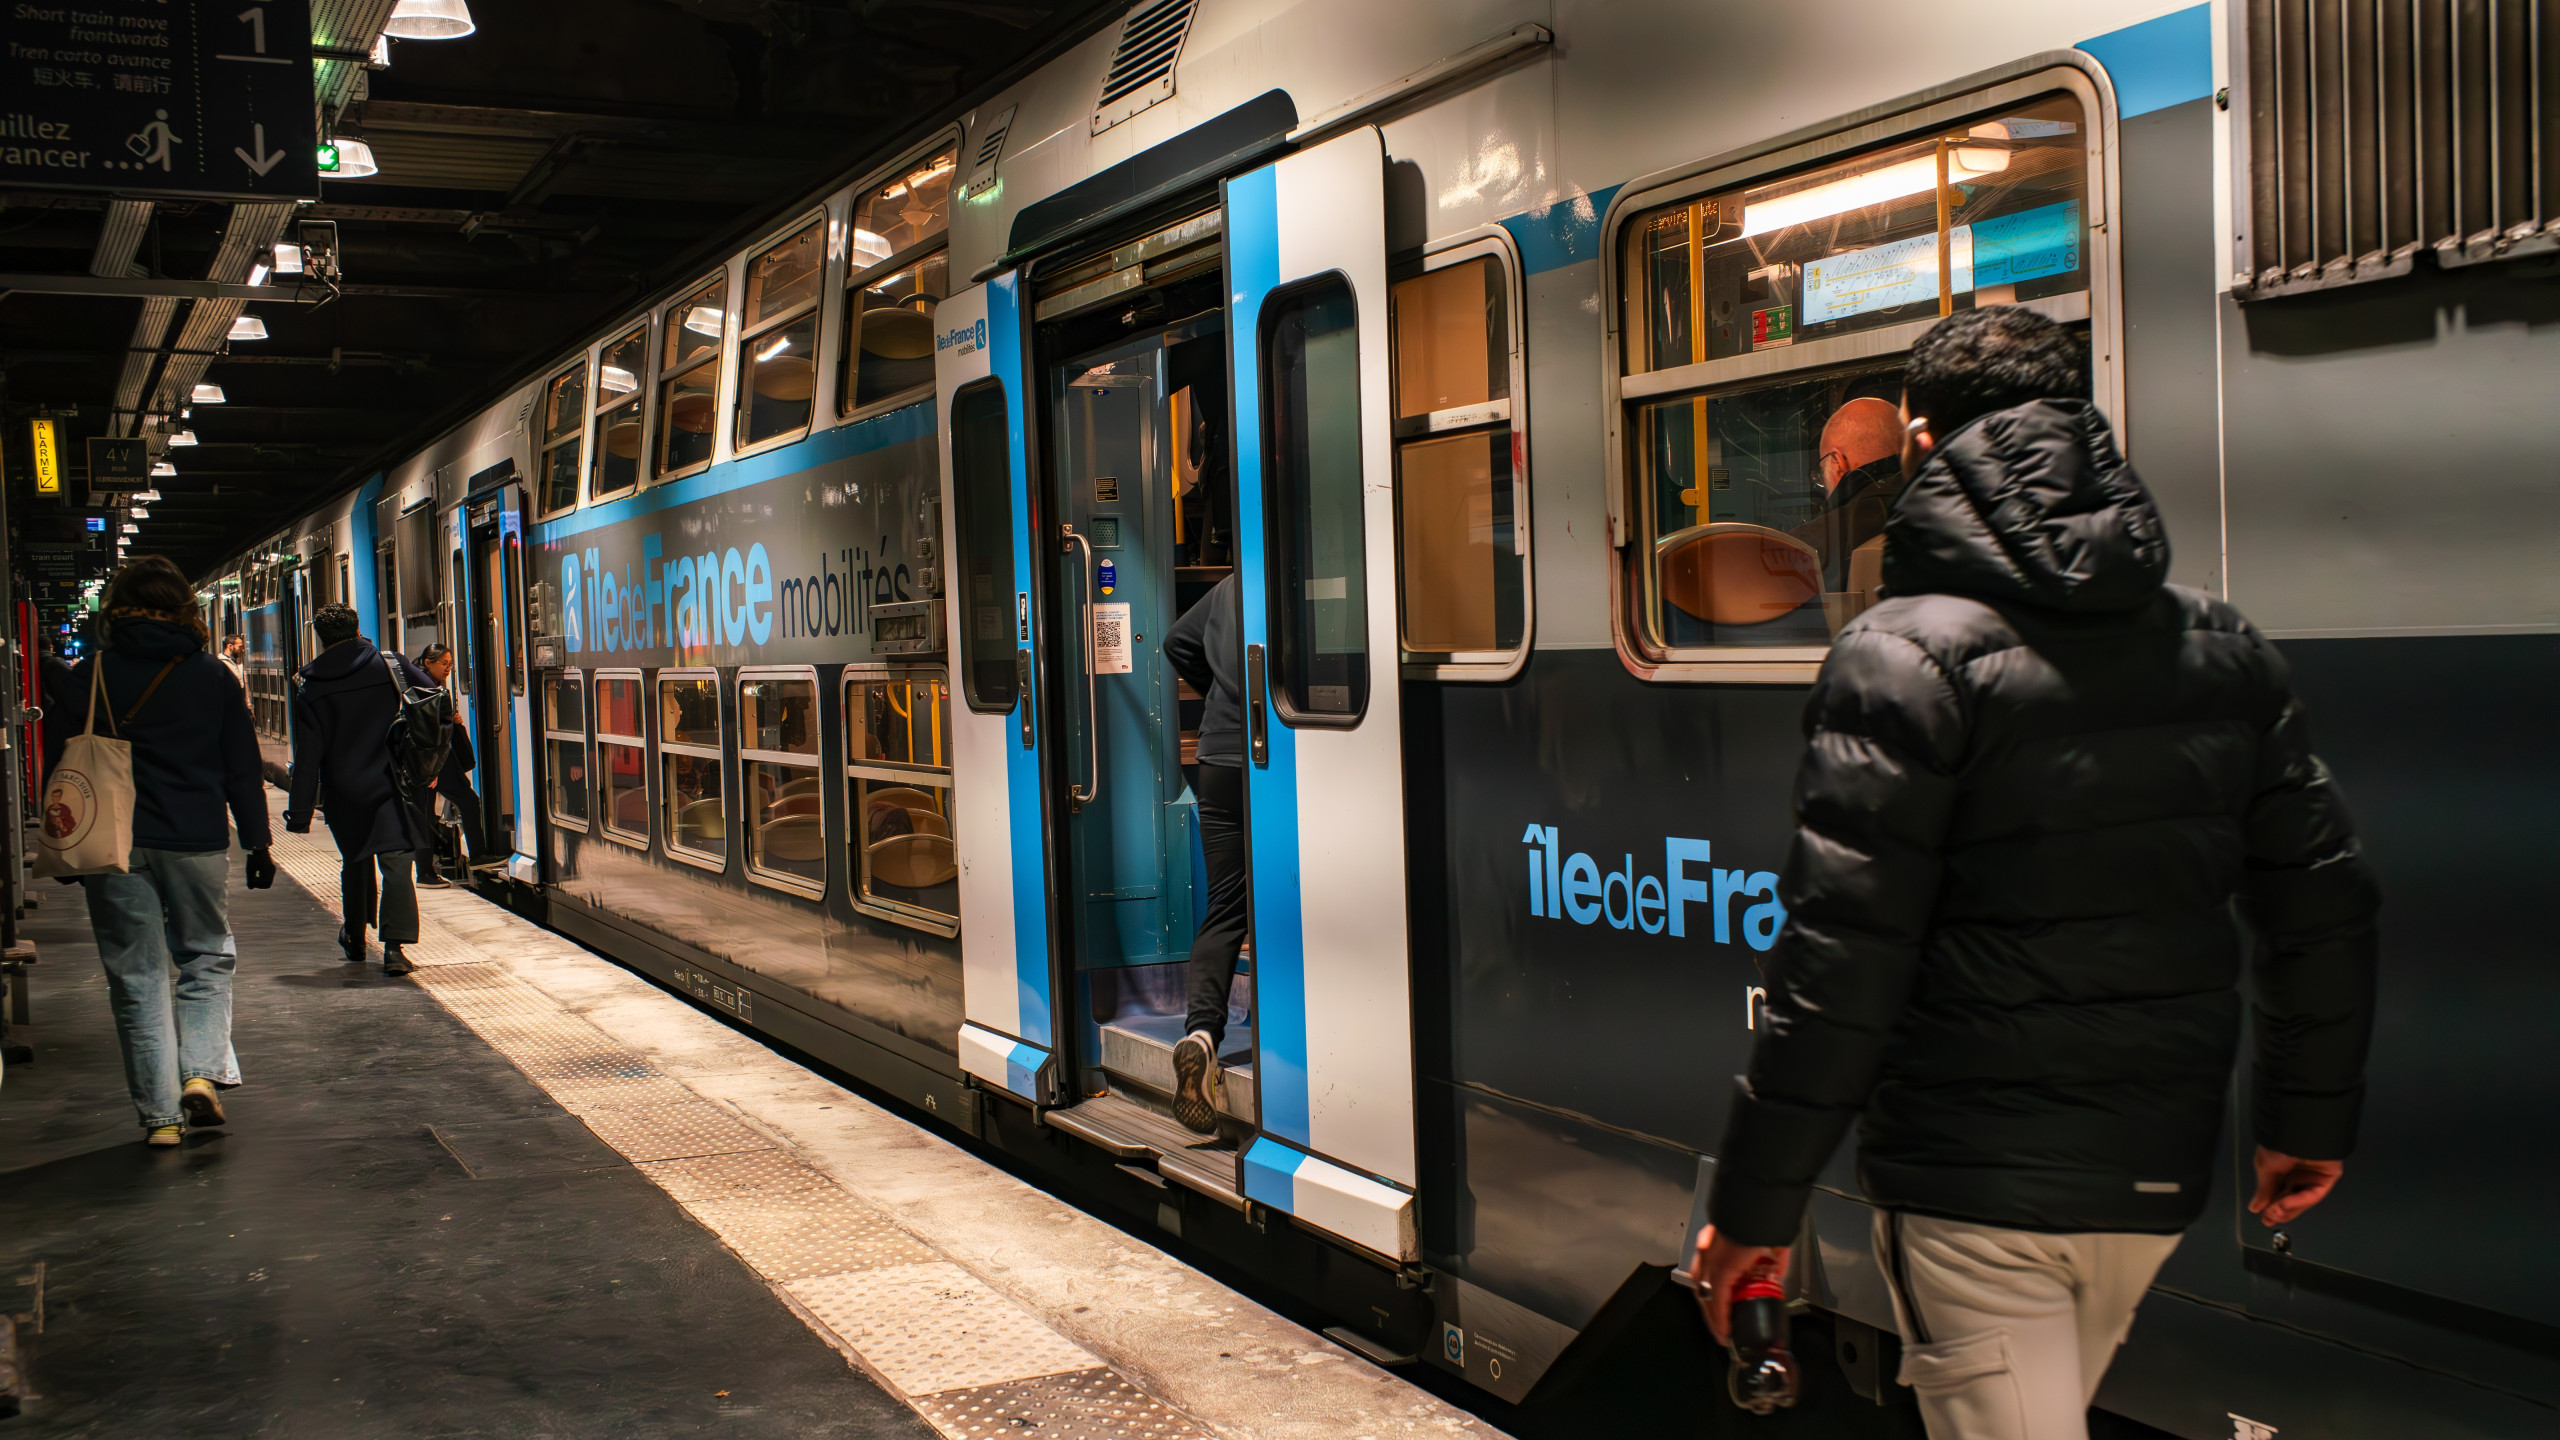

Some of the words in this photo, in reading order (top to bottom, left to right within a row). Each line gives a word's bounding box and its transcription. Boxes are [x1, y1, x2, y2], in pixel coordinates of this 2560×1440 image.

[14, 4, 65, 23] Short
[71, 10, 114, 26] train
[119, 16, 169, 31] move
[237, 7, 266, 54] 1
[70, 26, 170, 48] frontwards
[8, 41, 49, 61] Tren
[54, 50, 103, 64] corto
[107, 54, 172, 69] avance
[37, 422, 49, 475] ALARME
[106, 448, 116, 462] 4
[780, 535, 911, 639] mobilités
